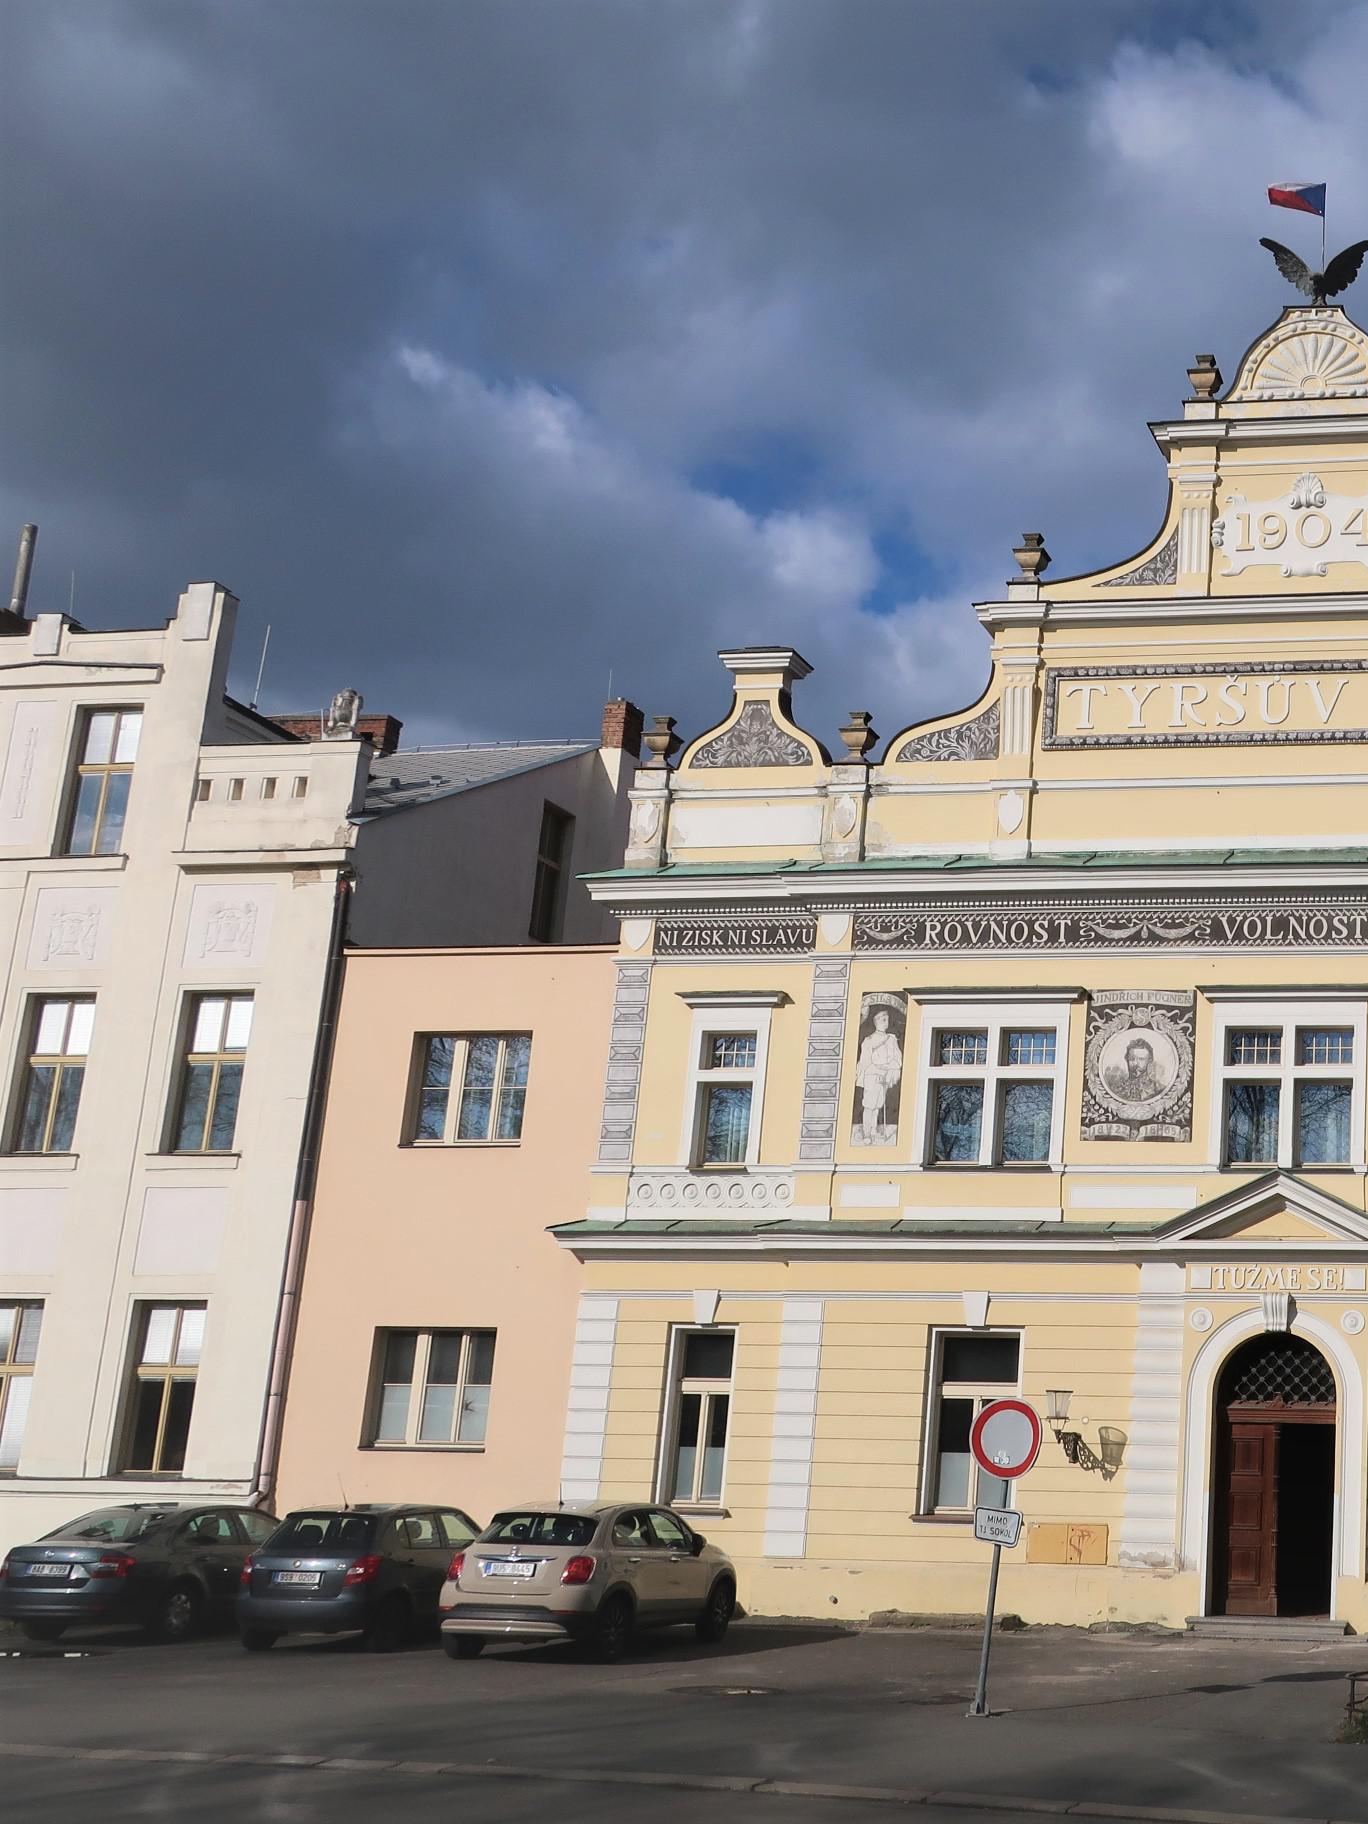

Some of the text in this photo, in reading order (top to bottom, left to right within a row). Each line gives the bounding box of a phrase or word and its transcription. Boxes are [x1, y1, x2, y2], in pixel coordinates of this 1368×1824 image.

[1065, 674, 1350, 730] TYRŠŮV
[658, 930, 678, 946] NI
[682, 930, 724, 946] ZISK
[727, 929, 747, 945] NI
[923, 918, 1072, 944] ROVNOST
[1219, 916, 1368, 941] VOLNOST
[1305, 1267, 1345, 1291] SE!
[987, 1514, 1008, 1525] MIMO
[990, 1526, 1012, 1538] SOKOL
